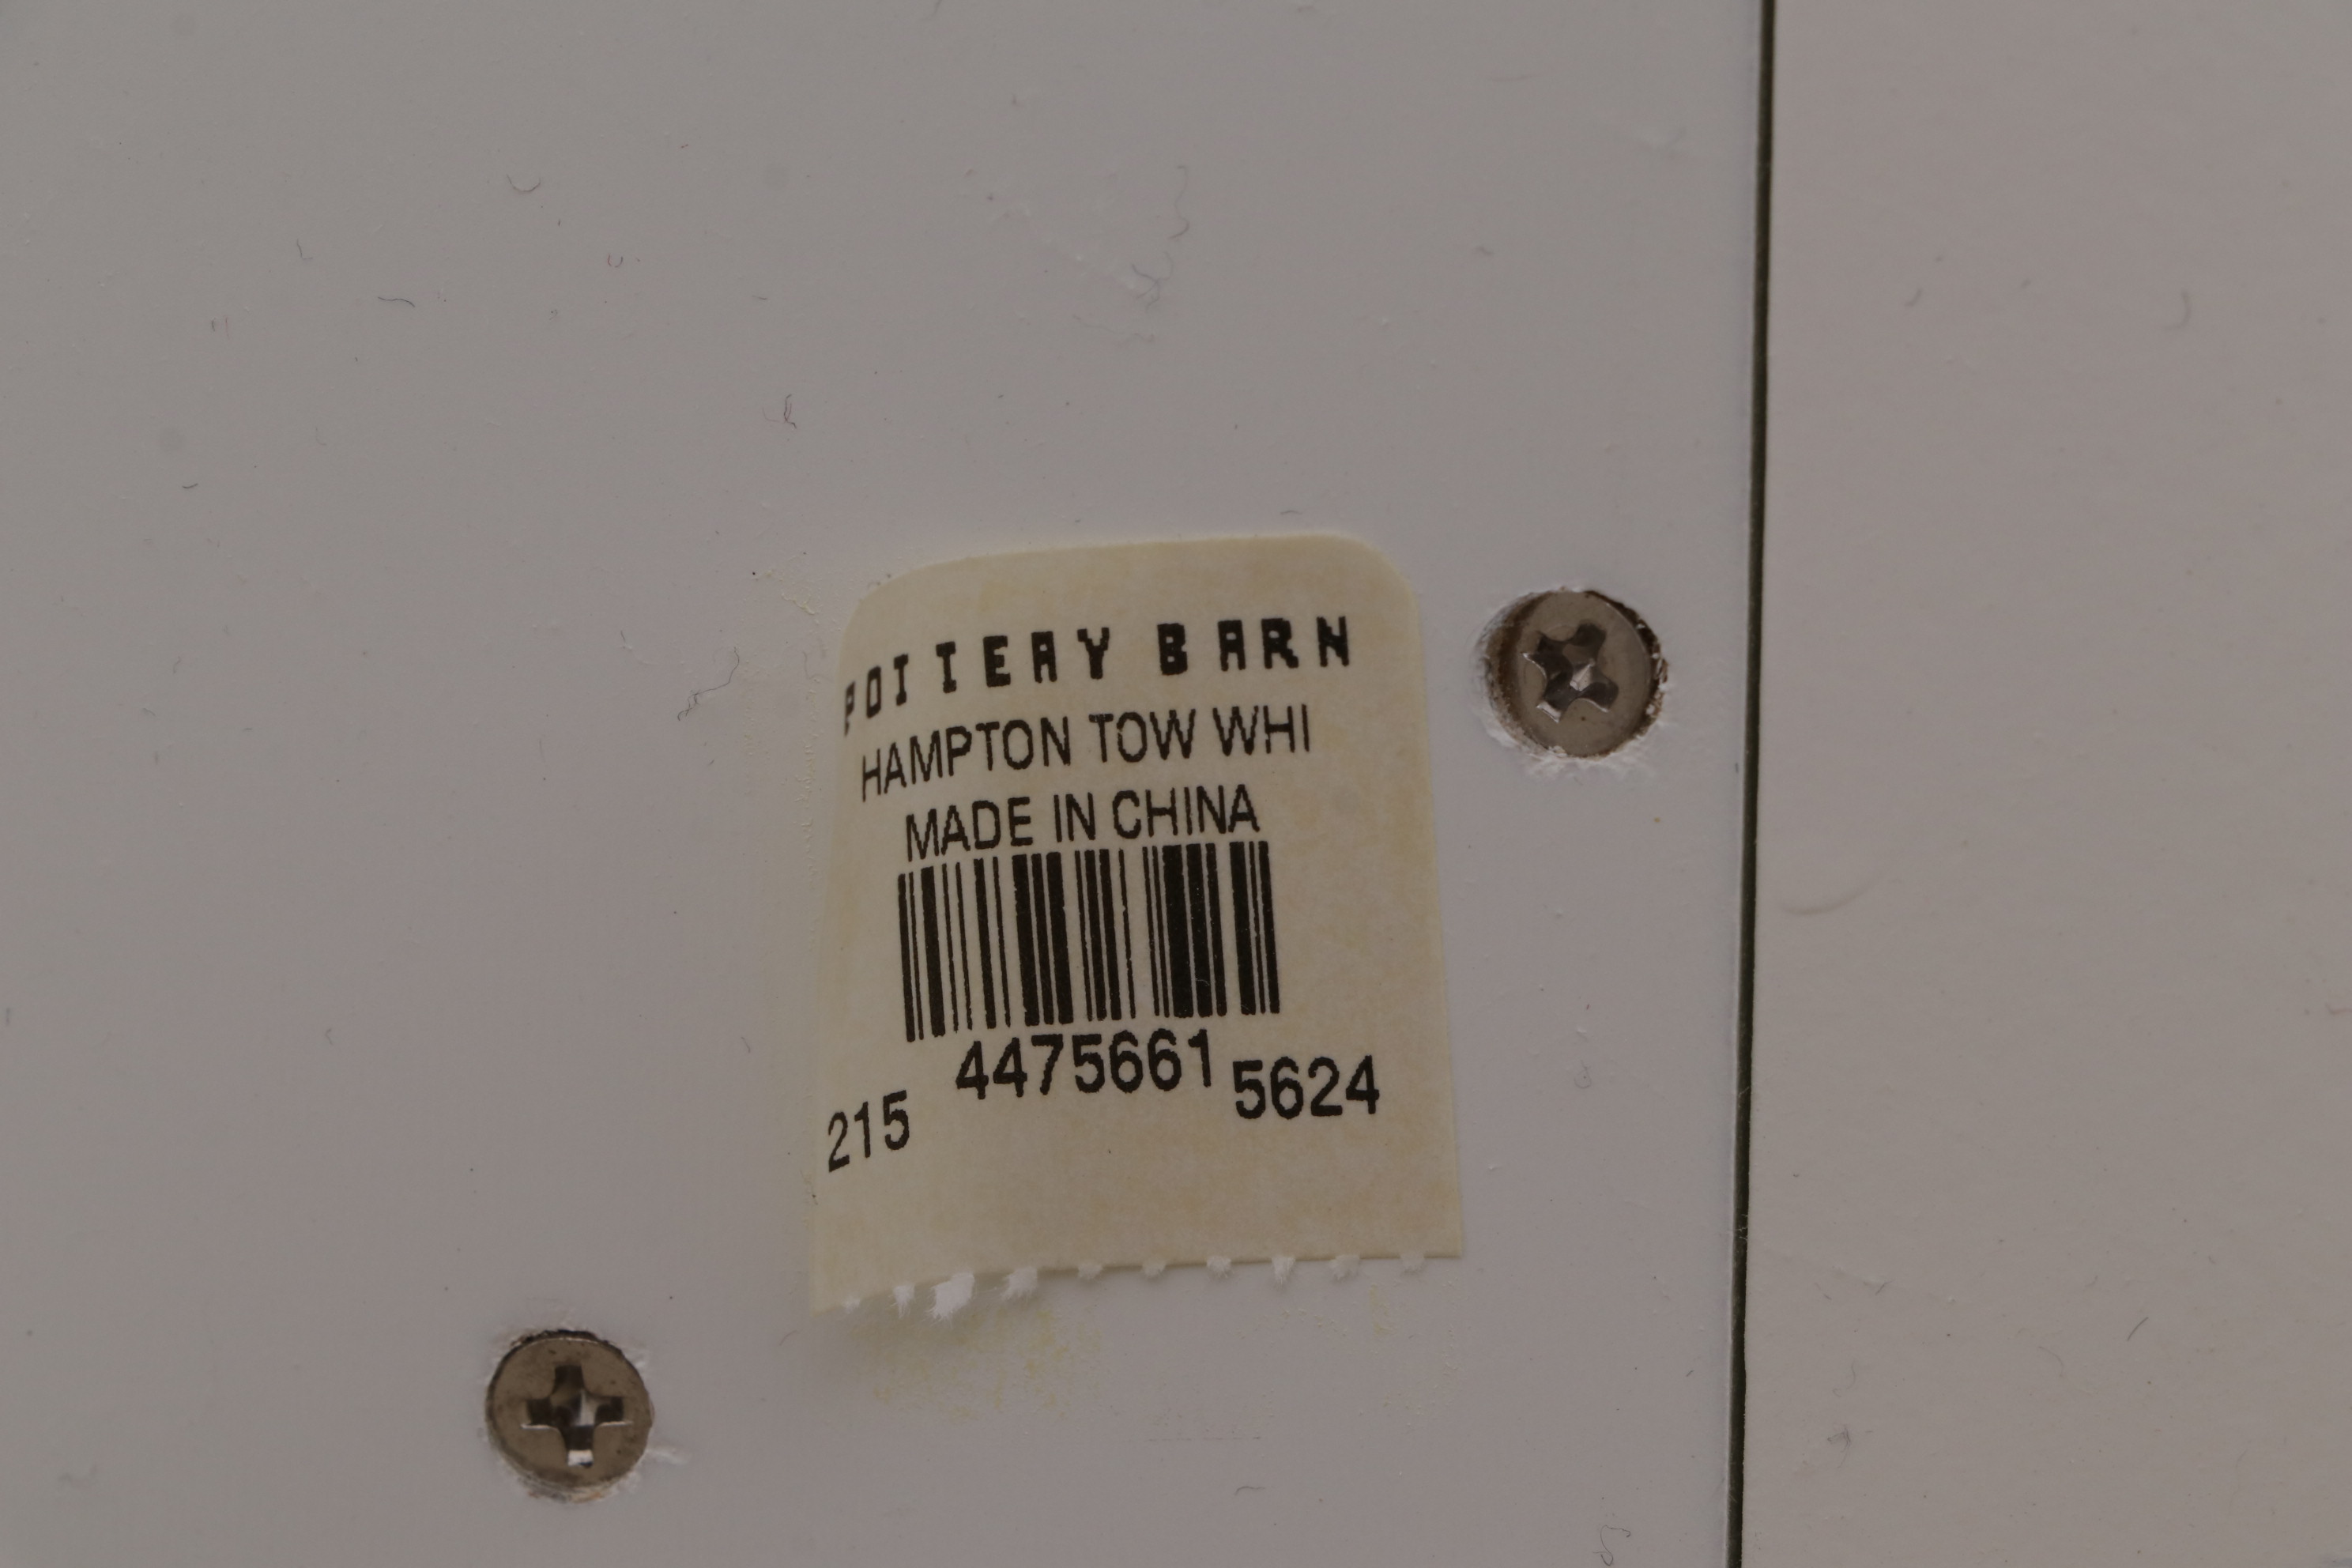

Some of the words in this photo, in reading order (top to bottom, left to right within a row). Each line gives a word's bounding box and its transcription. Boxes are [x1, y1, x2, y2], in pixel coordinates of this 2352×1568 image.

[1156, 616, 1350, 677] BARN
[861, 715, 1072, 802] HAMPTON
[1087, 708, 1197, 763] TOW
[1212, 703, 1310, 757] WHI
[906, 796, 1034, 862] MADE
[1053, 791, 1096, 843] IN
[1111, 783, 1261, 840] CHINA
[955, 1027, 1212, 1100] 4475661
[1232, 1054, 1381, 1121] 5624
[827, 1089, 910, 1173] 215
